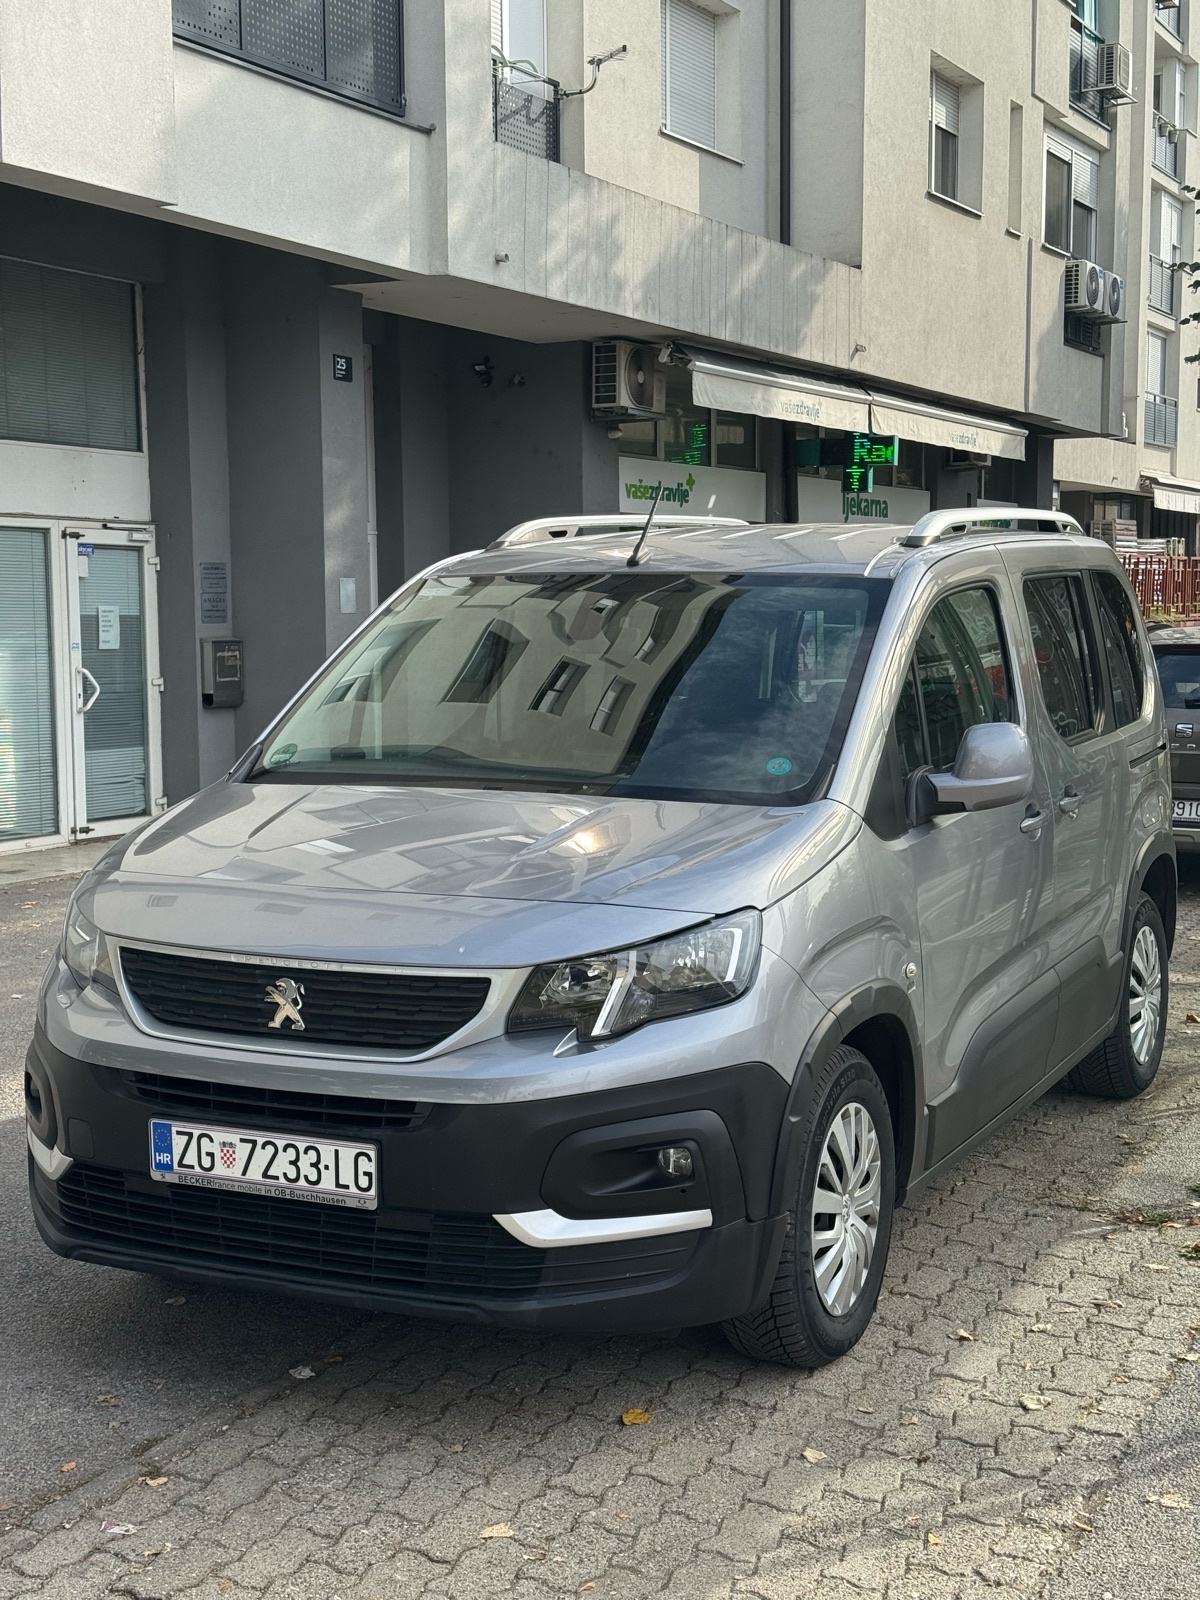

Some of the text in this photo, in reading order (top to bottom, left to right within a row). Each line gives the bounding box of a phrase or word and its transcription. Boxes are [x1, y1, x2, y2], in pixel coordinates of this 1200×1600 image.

[335, 357, 347, 371] 25
[243, 955, 330, 970] PEUGEOT
[155, 1152, 172, 1165] HR
[176, 1130, 216, 1172] ZG
[237, 1184, 263, 1193] mobile
[264, 1186, 272, 1195] in
[274, 1188, 346, 1205] OB-Buschhausen
